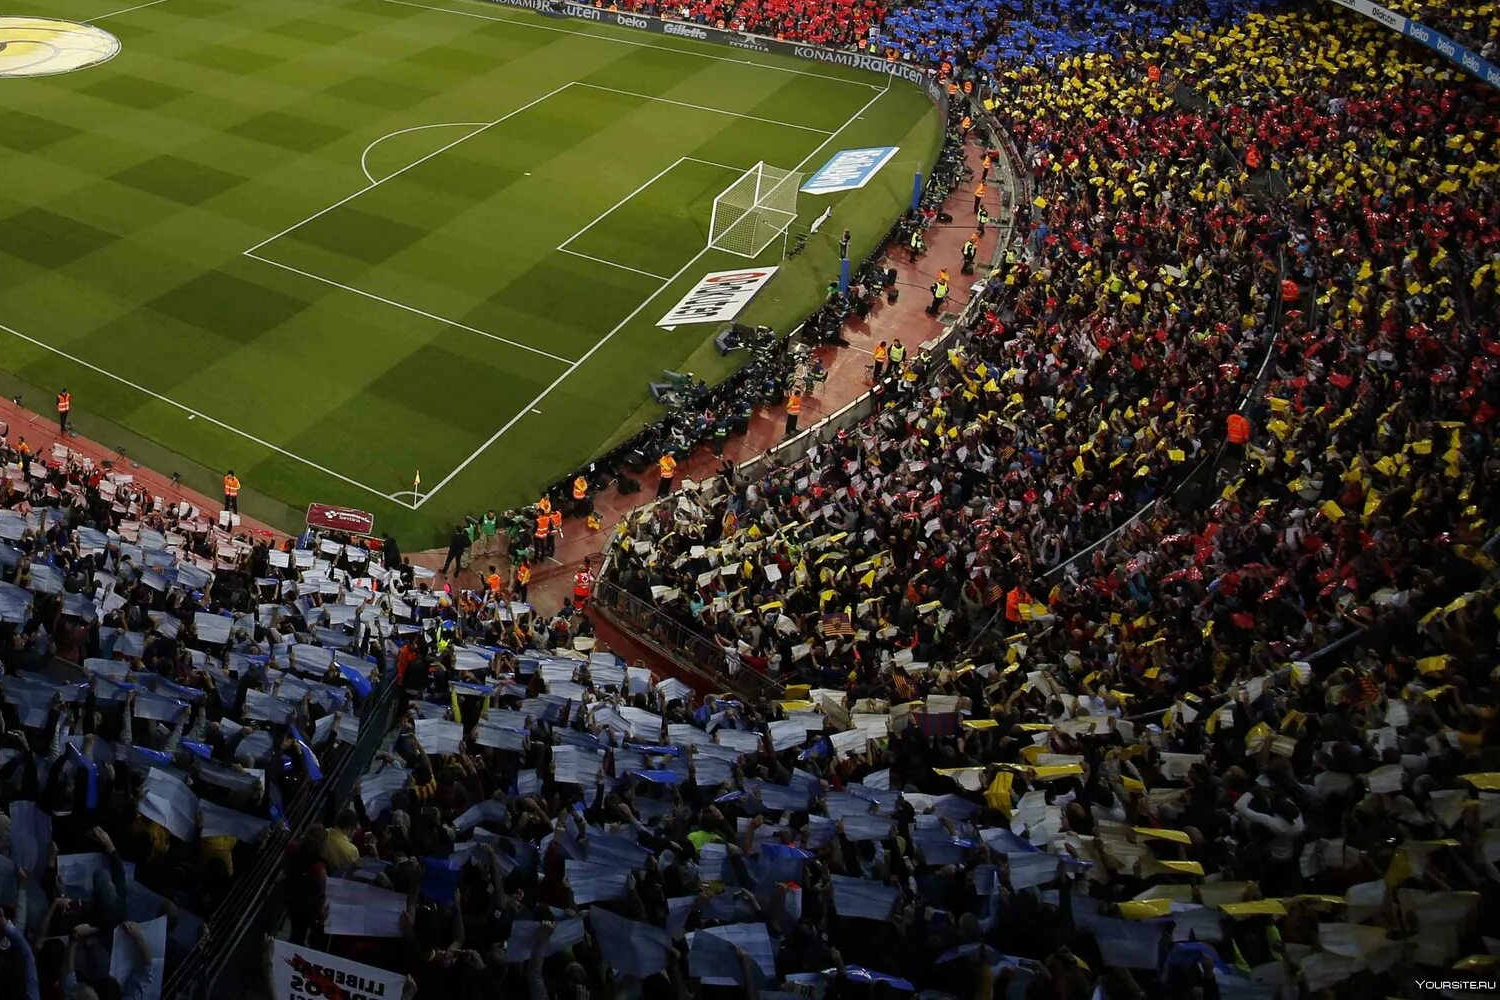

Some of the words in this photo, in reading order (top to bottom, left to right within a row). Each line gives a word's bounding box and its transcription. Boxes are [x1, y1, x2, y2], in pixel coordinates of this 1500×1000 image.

[617, 14, 647, 29] beko
[1376, 9, 1396, 25] Rakuten
[663, 23, 707, 40] Gillette
[1409, 22, 1429, 43] beko
[794, 46, 852, 66] KONAMI
[1436, 37, 1455, 57] beko
[861, 58, 923, 85] Rakuten
[1462, 52, 1480, 73] beko
